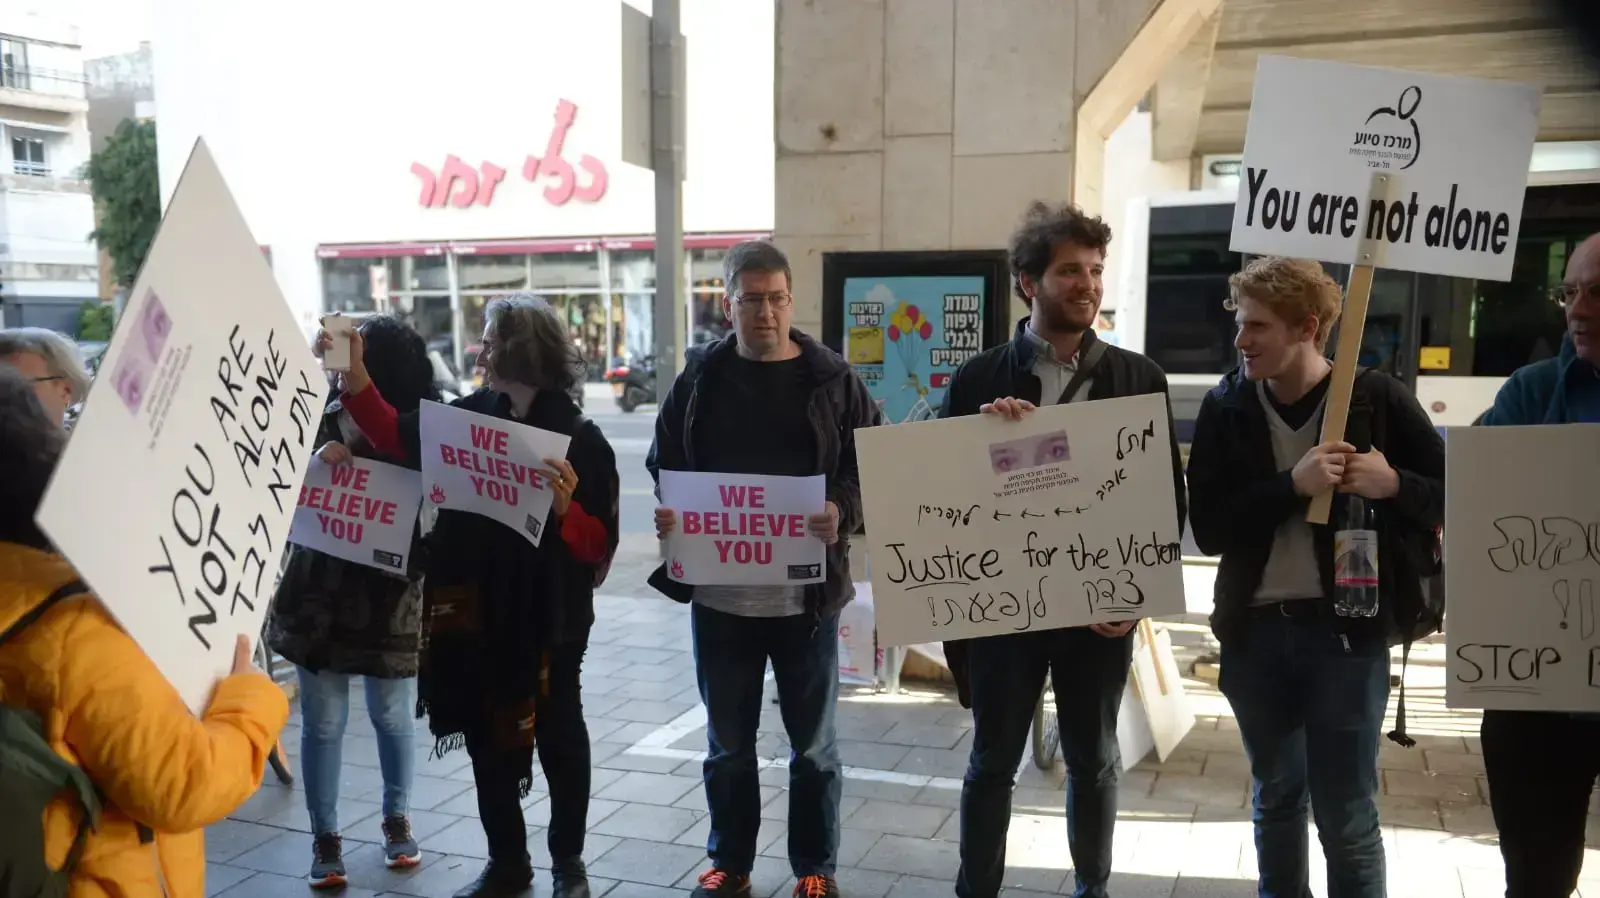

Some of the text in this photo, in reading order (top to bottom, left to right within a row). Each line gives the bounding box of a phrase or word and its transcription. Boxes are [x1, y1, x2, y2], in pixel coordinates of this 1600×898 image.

[410, 98, 609, 208] כלי זמר
[1354, 132, 1412, 149] מרכז סיוע
[1246, 167, 1510, 254] You are not alone
[944, 295, 979, 311] עמדת
[944, 313, 979, 329] ניפוח
[944, 329, 978, 348] גלגלי
[470, 423, 509, 456] WE
[149, 443, 217, 604] YOU
[210, 324, 254, 442] ARE
[330, 464, 370, 492] WE
[440, 443, 545, 490] BELIEVE
[1008, 474, 1025, 482] הסיוע
[188, 328, 288, 652] NOT ALONE
[229, 370, 318, 617] את לא לבד
[470, 475, 518, 506] YOU
[718, 485, 765, 508] WE
[1095, 468, 1128, 501] אביב
[316, 512, 363, 544] YOU
[682, 511, 804, 537] BELIEVE
[918, 504, 981, 528] לקפריסין
[714, 540, 772, 564] YOU
[885, 543, 1003, 583] Justice
[1023, 531, 1059, 568] for
[1066, 533, 1110, 571] the
[1082, 569, 1145, 616] צדק
[1456, 643, 1562, 683] STOP
